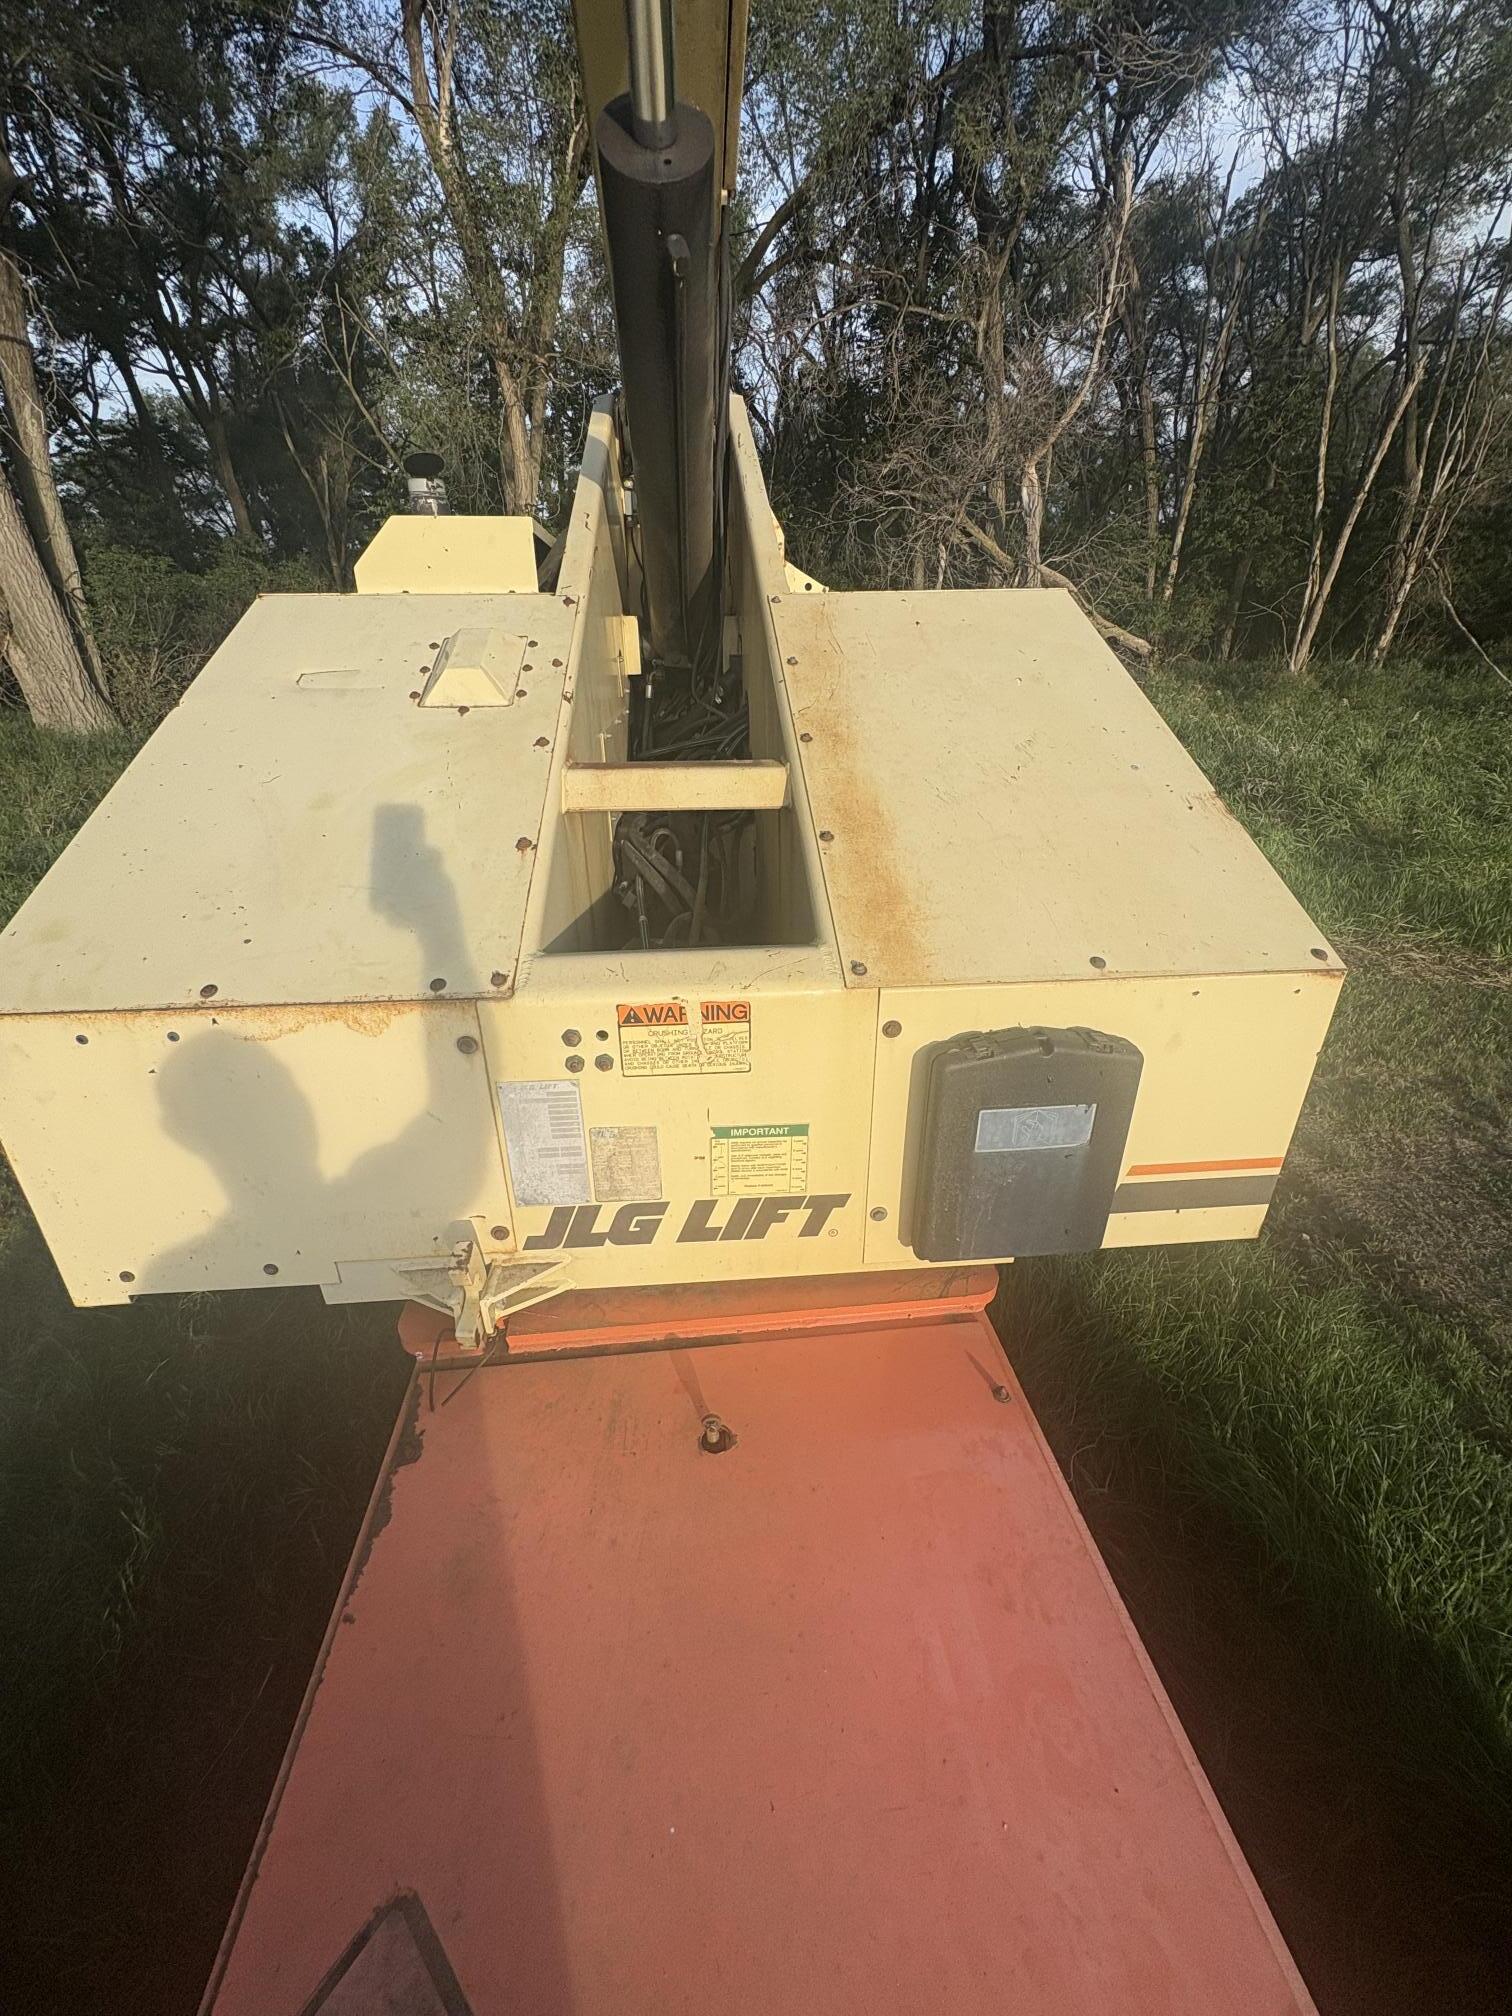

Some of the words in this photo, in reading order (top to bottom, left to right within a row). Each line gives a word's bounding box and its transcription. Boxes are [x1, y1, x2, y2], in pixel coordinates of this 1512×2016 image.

[730, 1127, 789, 1137] IMPORTANT
[522, 1201, 671, 1250] JLG
[675, 1193, 852, 1243] LIFT
